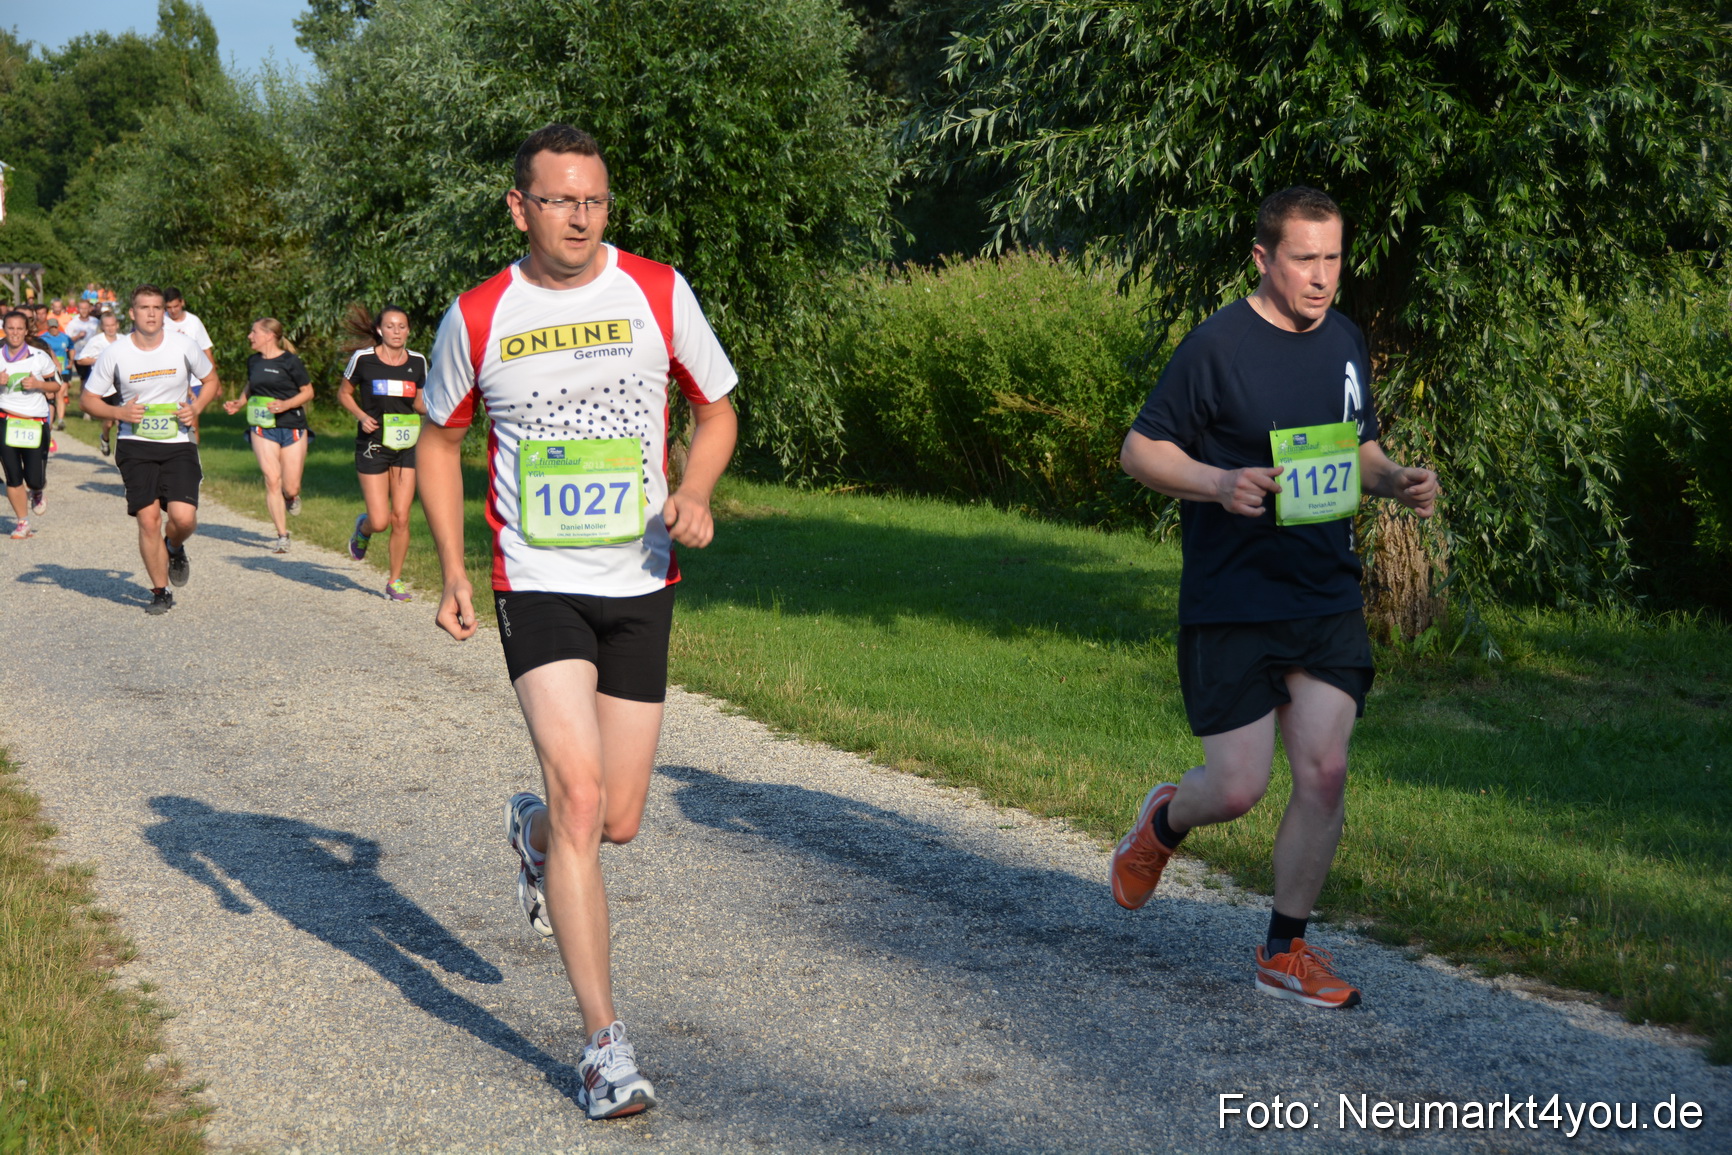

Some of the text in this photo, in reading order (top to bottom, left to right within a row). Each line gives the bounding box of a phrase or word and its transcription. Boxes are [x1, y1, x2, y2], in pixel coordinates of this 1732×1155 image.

[506, 323, 621, 356] ONLINE
[573, 347, 633, 360] Germany
[142, 418, 169, 430] 532
[14, 430, 34, 441] 118
[396, 429, 410, 441] 36
[539, 457, 581, 466] firmenlauf
[1286, 461, 1352, 498] 1127
[535, 482, 631, 516] 1027
